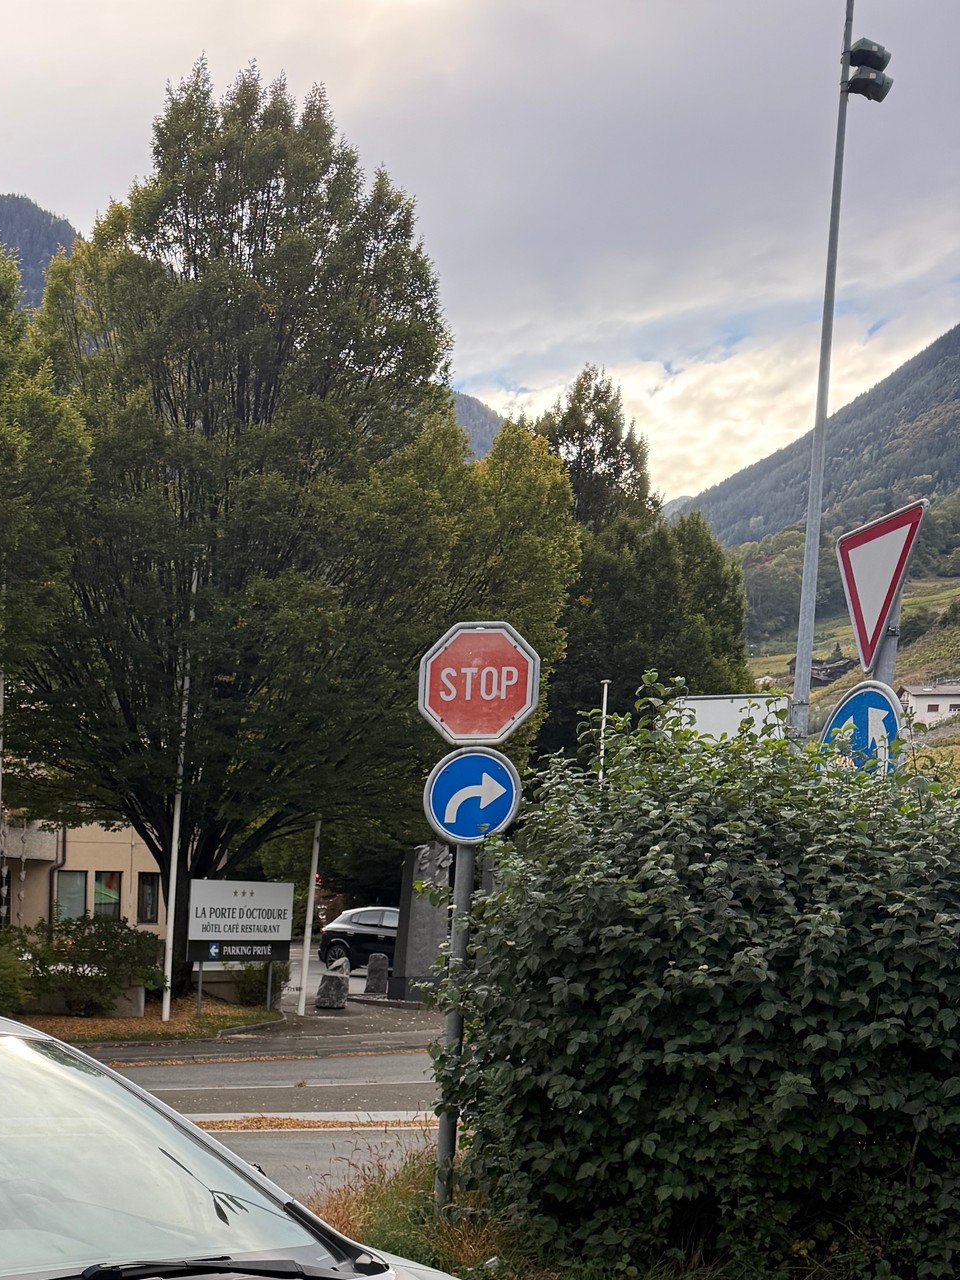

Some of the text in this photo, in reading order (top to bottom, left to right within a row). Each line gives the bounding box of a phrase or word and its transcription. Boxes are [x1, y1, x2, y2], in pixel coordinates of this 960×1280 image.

[440, 666, 519, 702] STOP
[195, 905, 288, 920] LA PORTE D'OCTODURE
[202, 922, 280, 933] HÔTEL CAFÉ RESTAURANT
[223, 944, 272, 955] PARKING PRIVÉ
